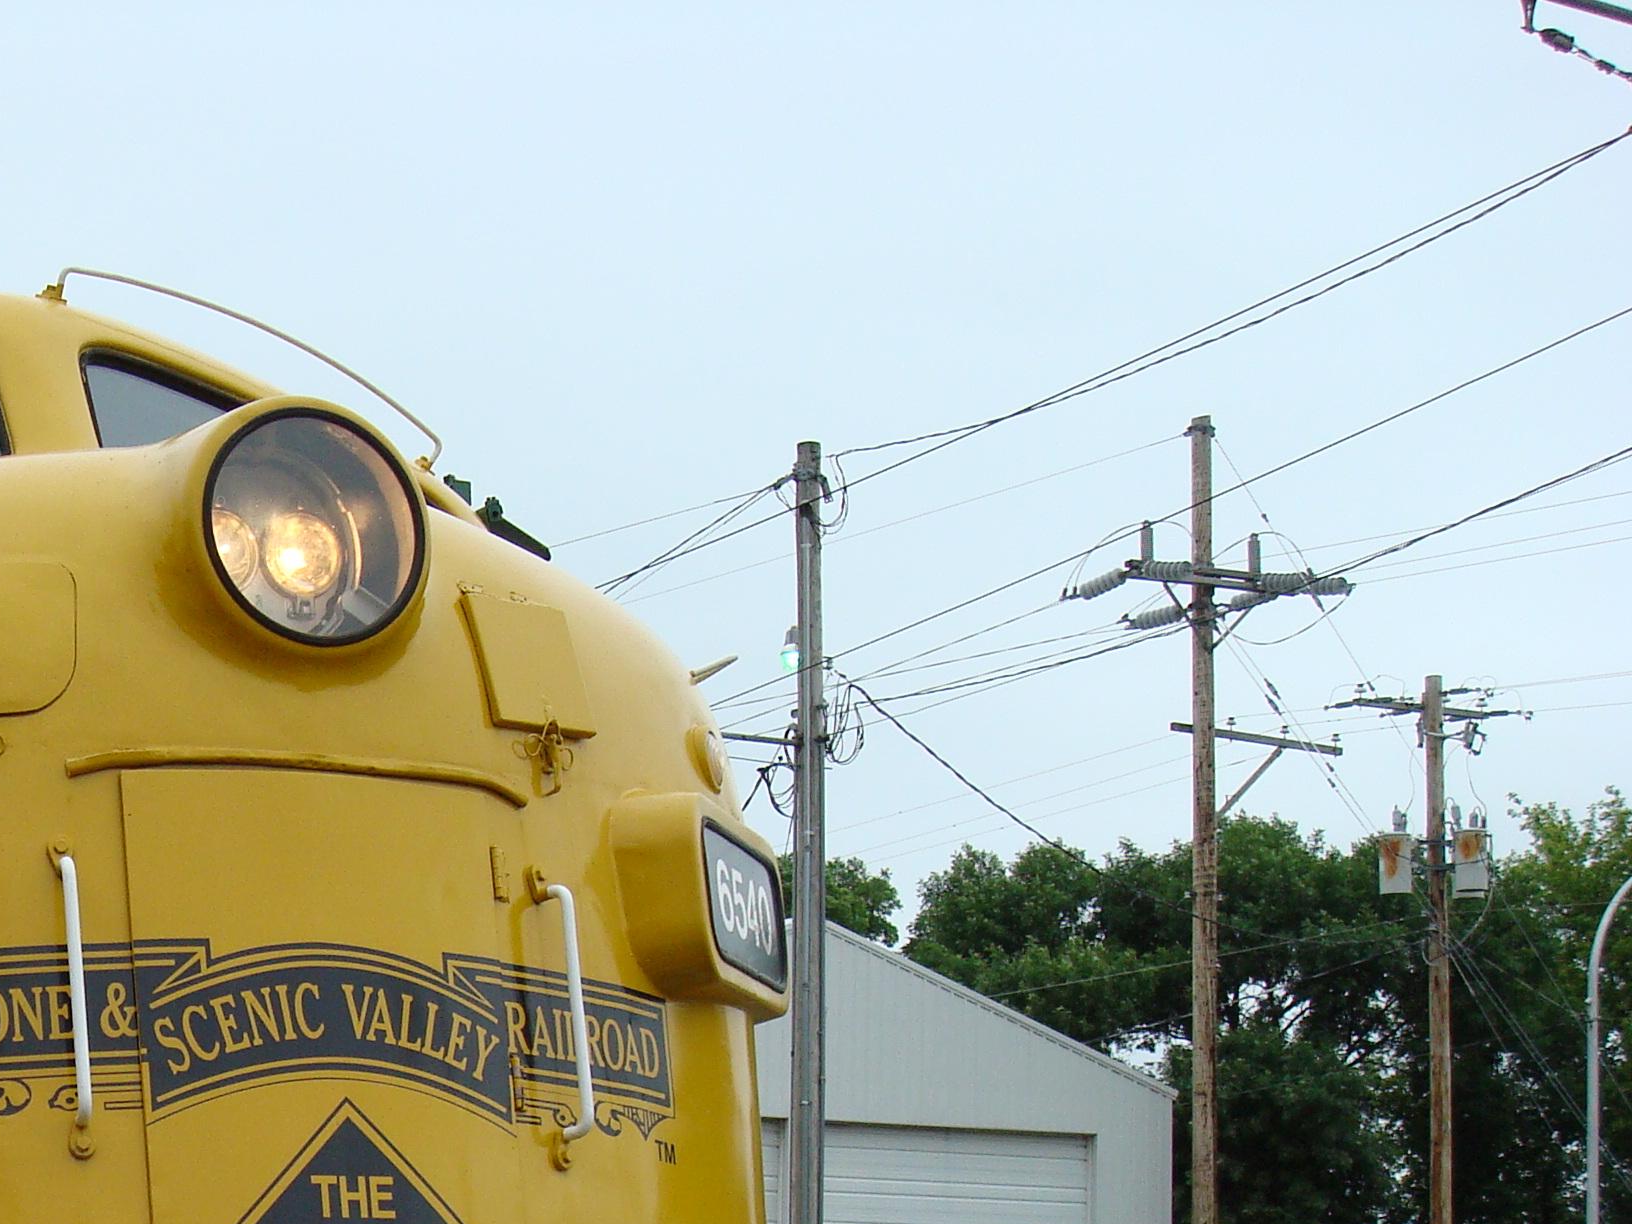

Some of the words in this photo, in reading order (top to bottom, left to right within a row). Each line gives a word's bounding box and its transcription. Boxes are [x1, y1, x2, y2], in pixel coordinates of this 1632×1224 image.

[716, 858, 772, 955] 6540
[99, 982, 139, 1038] &
[153, 982, 325, 1076] SCENIC
[341, 983, 500, 1082] VALLEY
[504, 1001, 660, 1079] RAILROAD
[655, 1140, 677, 1165] TM
[310, 1175, 396, 1219] THE
